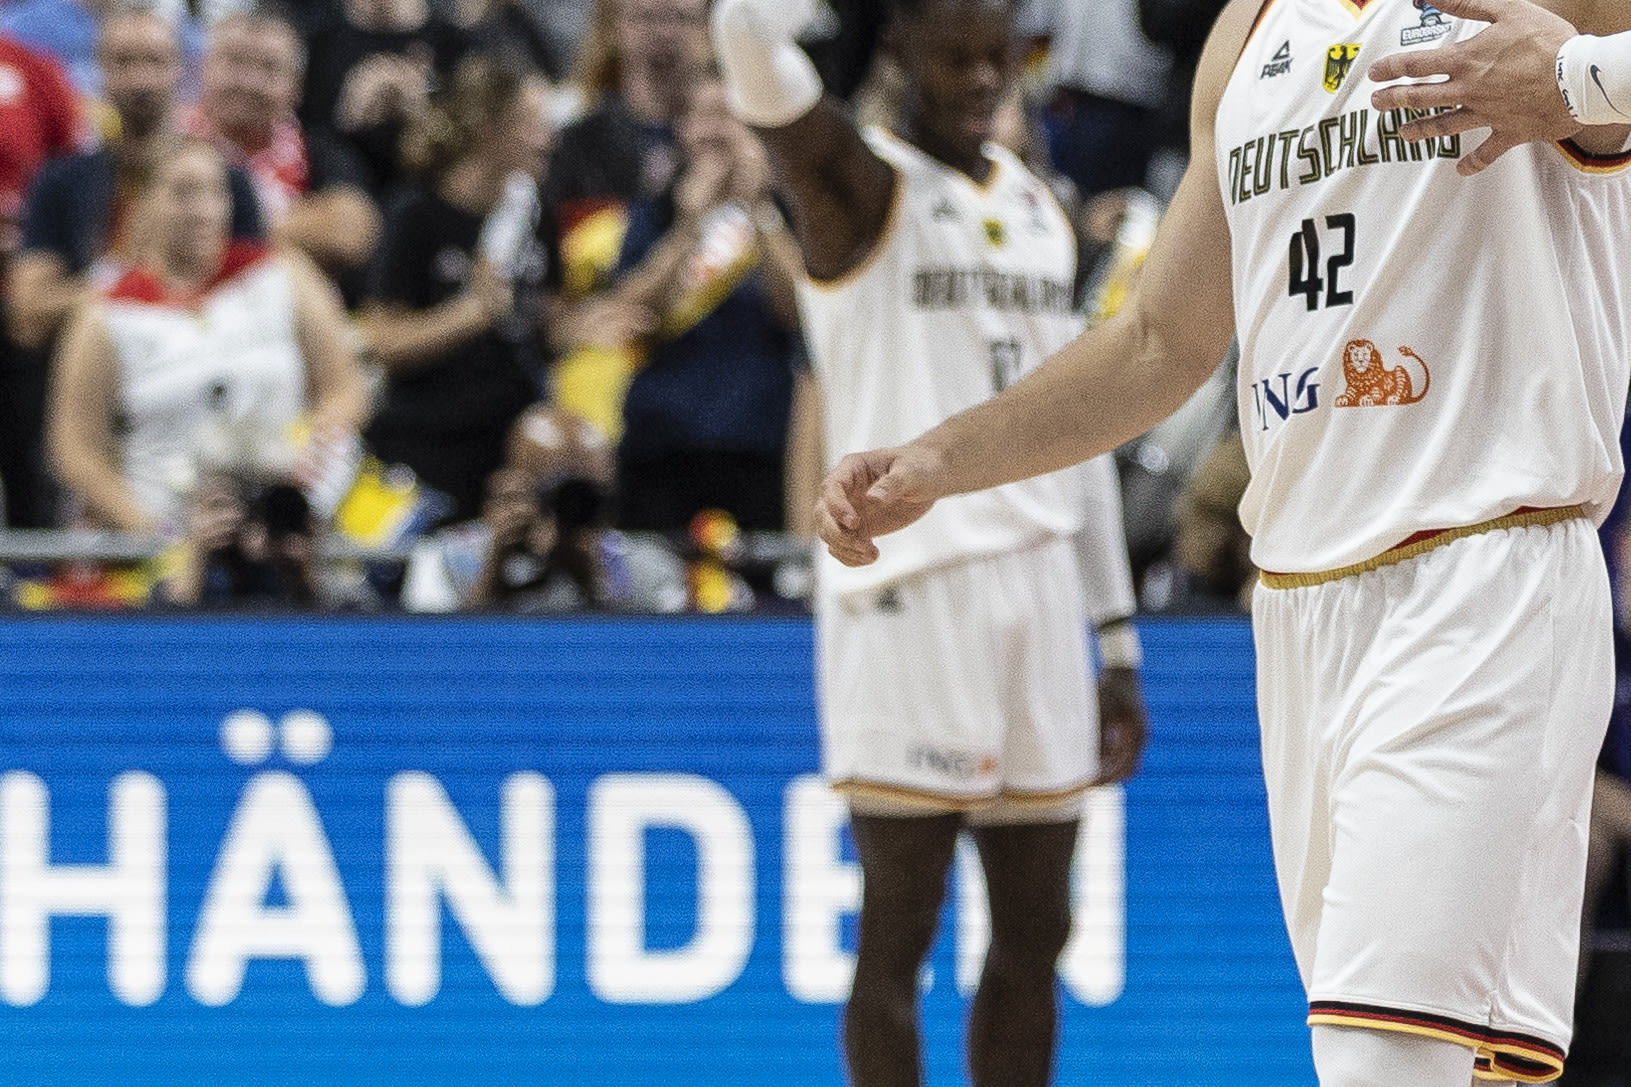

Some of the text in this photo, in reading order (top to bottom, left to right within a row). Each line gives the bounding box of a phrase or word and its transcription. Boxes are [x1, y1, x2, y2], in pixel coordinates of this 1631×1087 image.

[1260, 57, 1295, 80] PEAK
[1288, 212, 1356, 312] 42
[1252, 367, 1320, 431] ING
